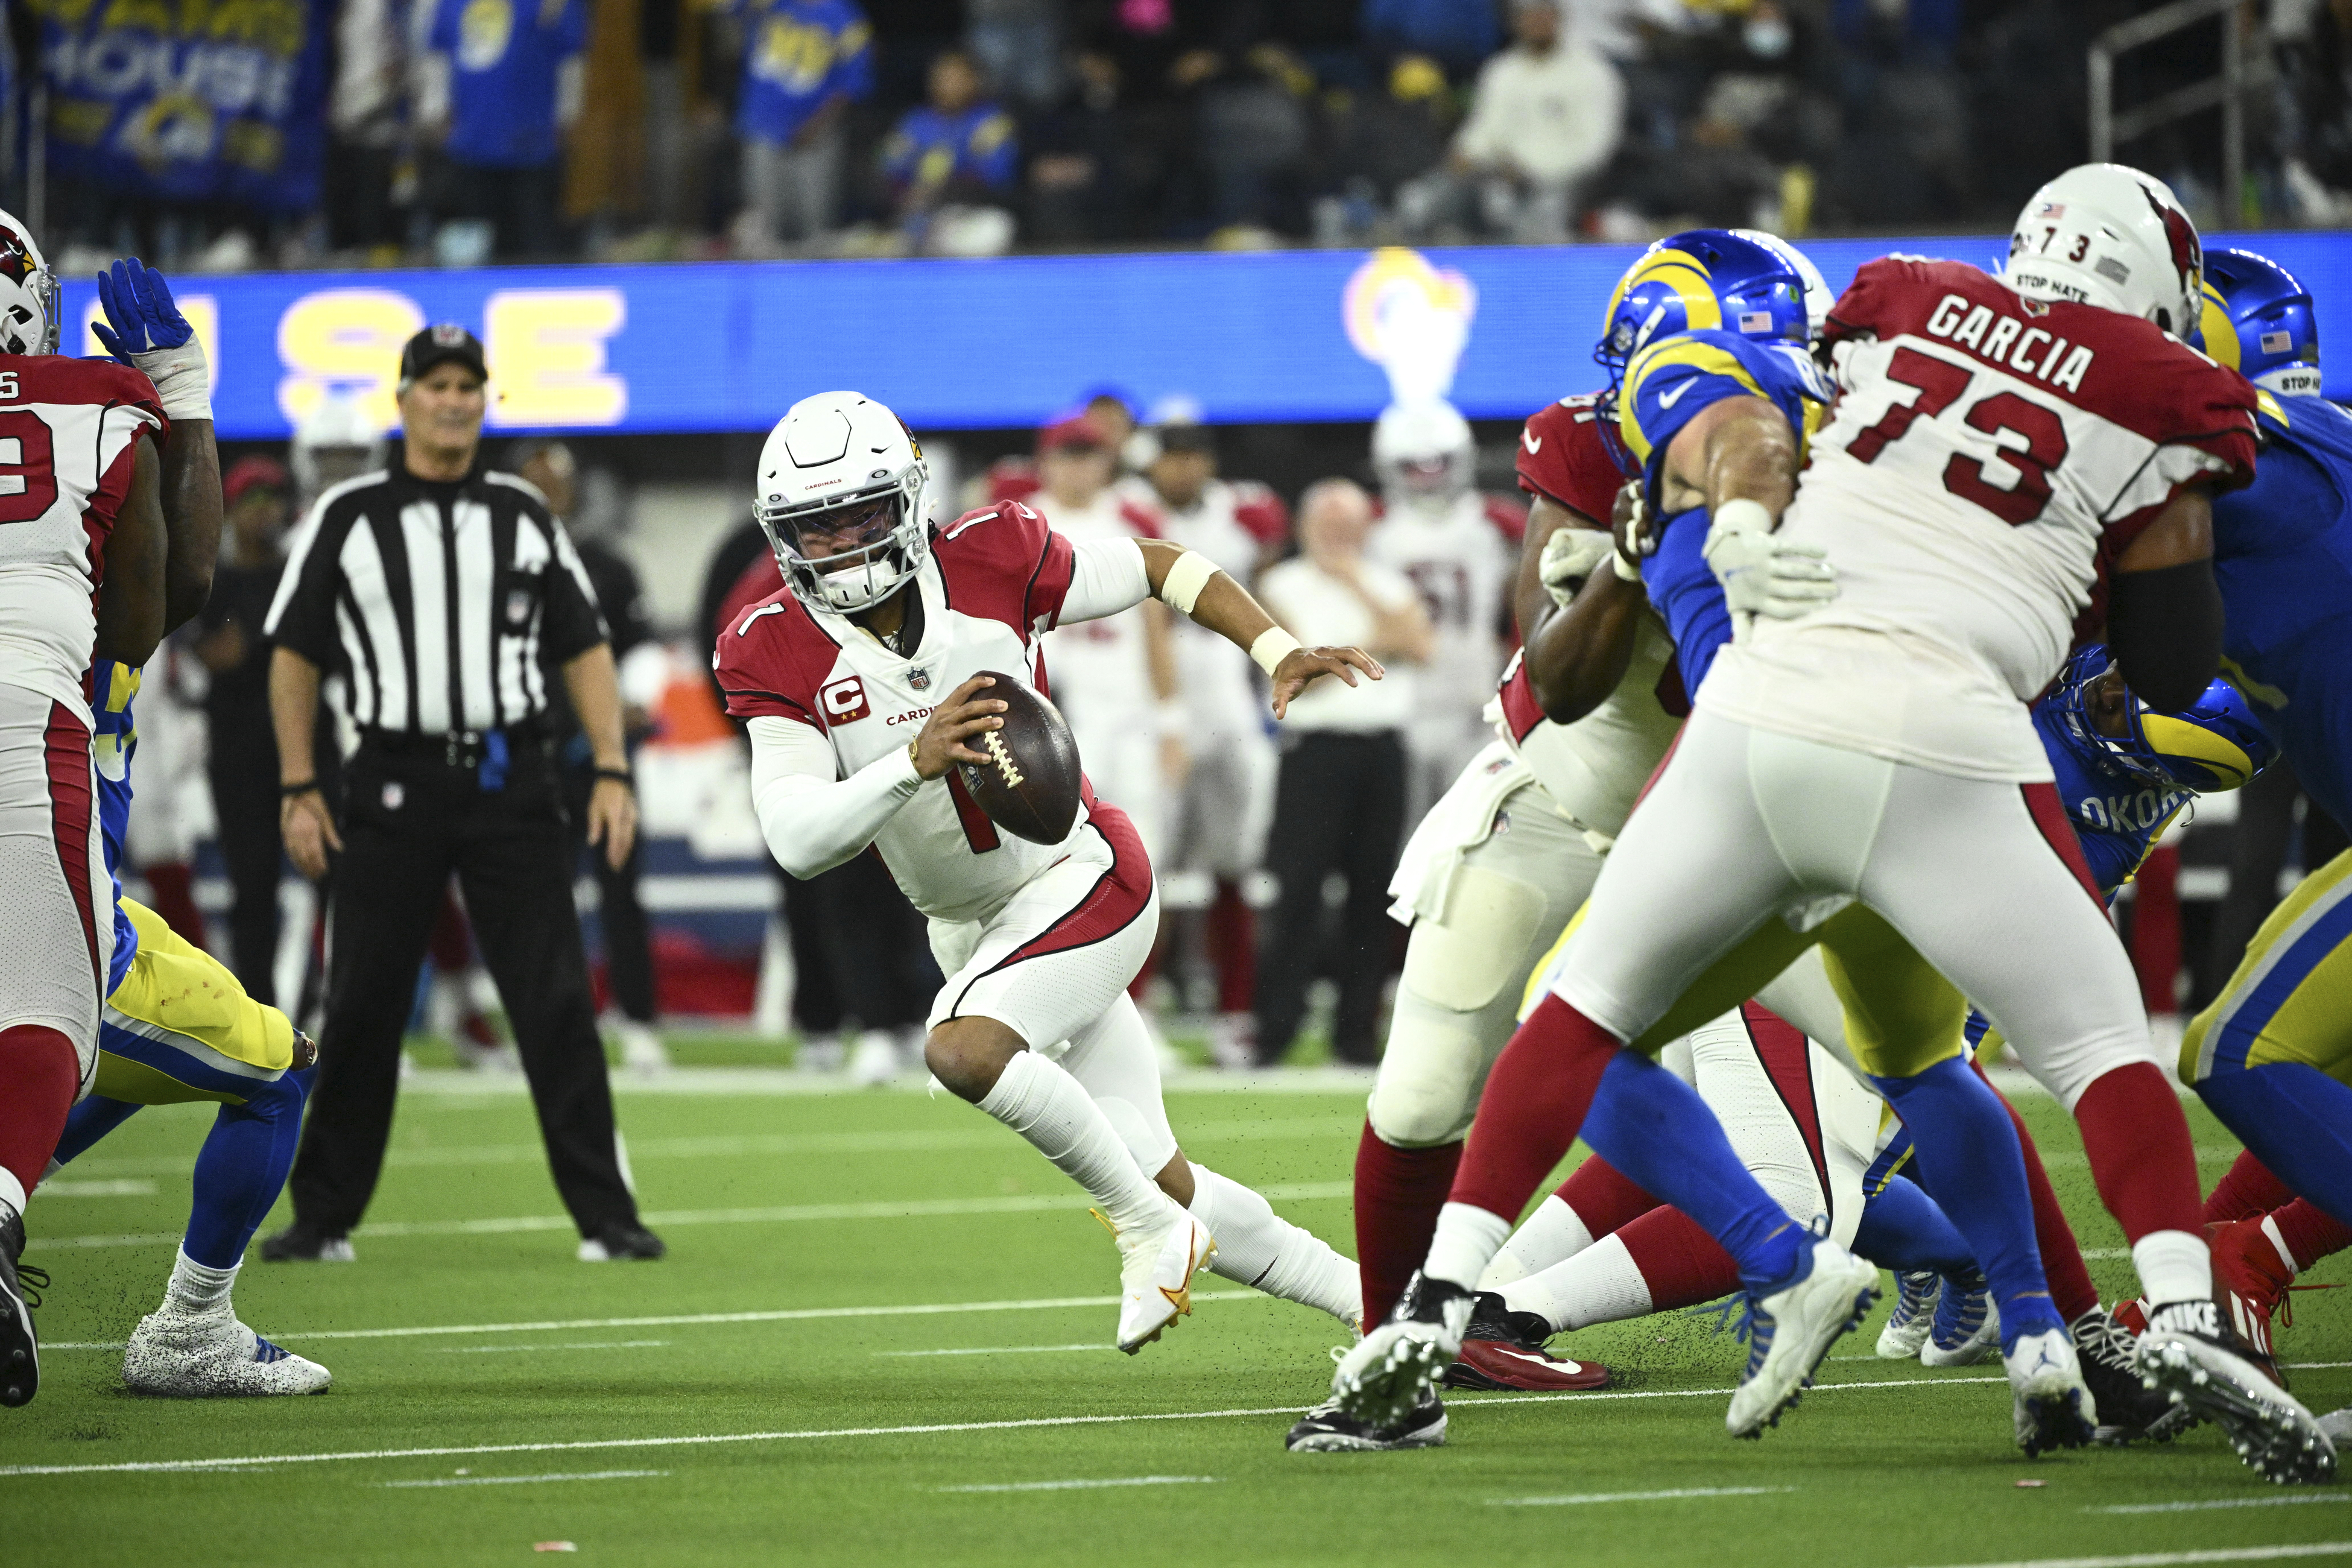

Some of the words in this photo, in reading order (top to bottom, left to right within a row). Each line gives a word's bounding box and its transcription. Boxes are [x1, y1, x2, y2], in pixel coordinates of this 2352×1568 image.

[2017, 274, 2047, 288] STOP
[1926, 294, 2093, 394] GARCIA
[2281, 376, 2311, 390] STOP
[1845, 346, 2069, 527] 73
[805, 478, 842, 490] CARDINALS
[824, 680, 863, 715] C
[886, 706, 937, 726] CARDI
